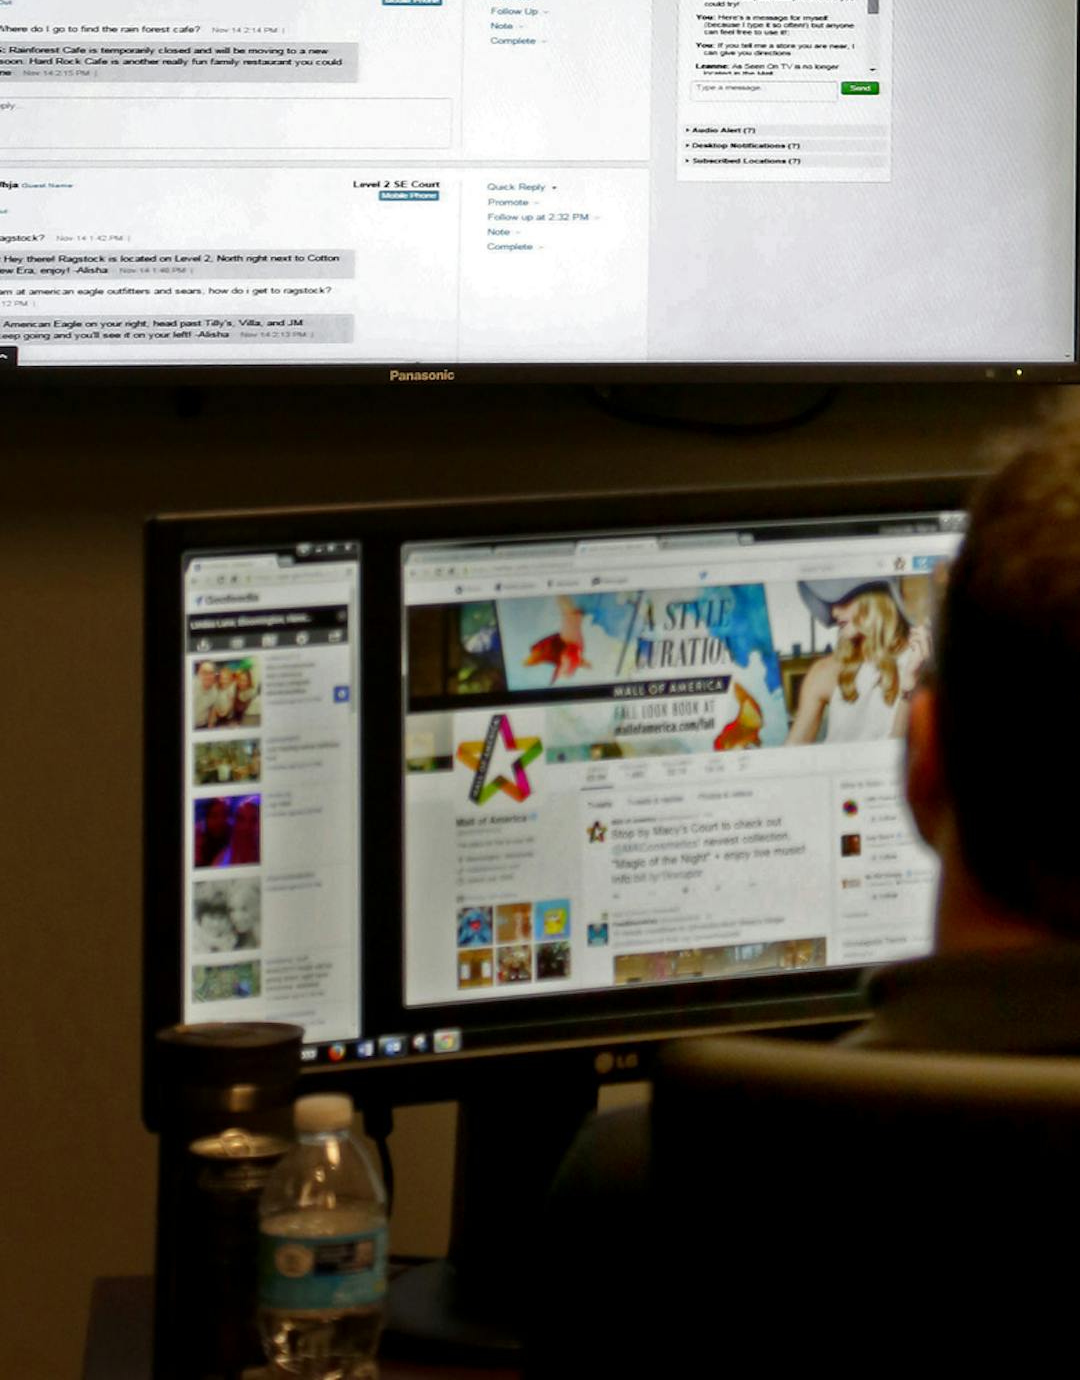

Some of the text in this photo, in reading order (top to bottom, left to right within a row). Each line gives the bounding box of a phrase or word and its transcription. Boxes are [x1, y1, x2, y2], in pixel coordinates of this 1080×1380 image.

[850, 84, 871, 92] Send
[411, 181, 440, 189] Court
[390, 369, 454, 381] Panasonic
[614, 681, 723, 697] MALL OF AMERICA
[614, 718, 716, 736] mallofamerica.com/fall
[617, 1055, 638, 1067] LG
